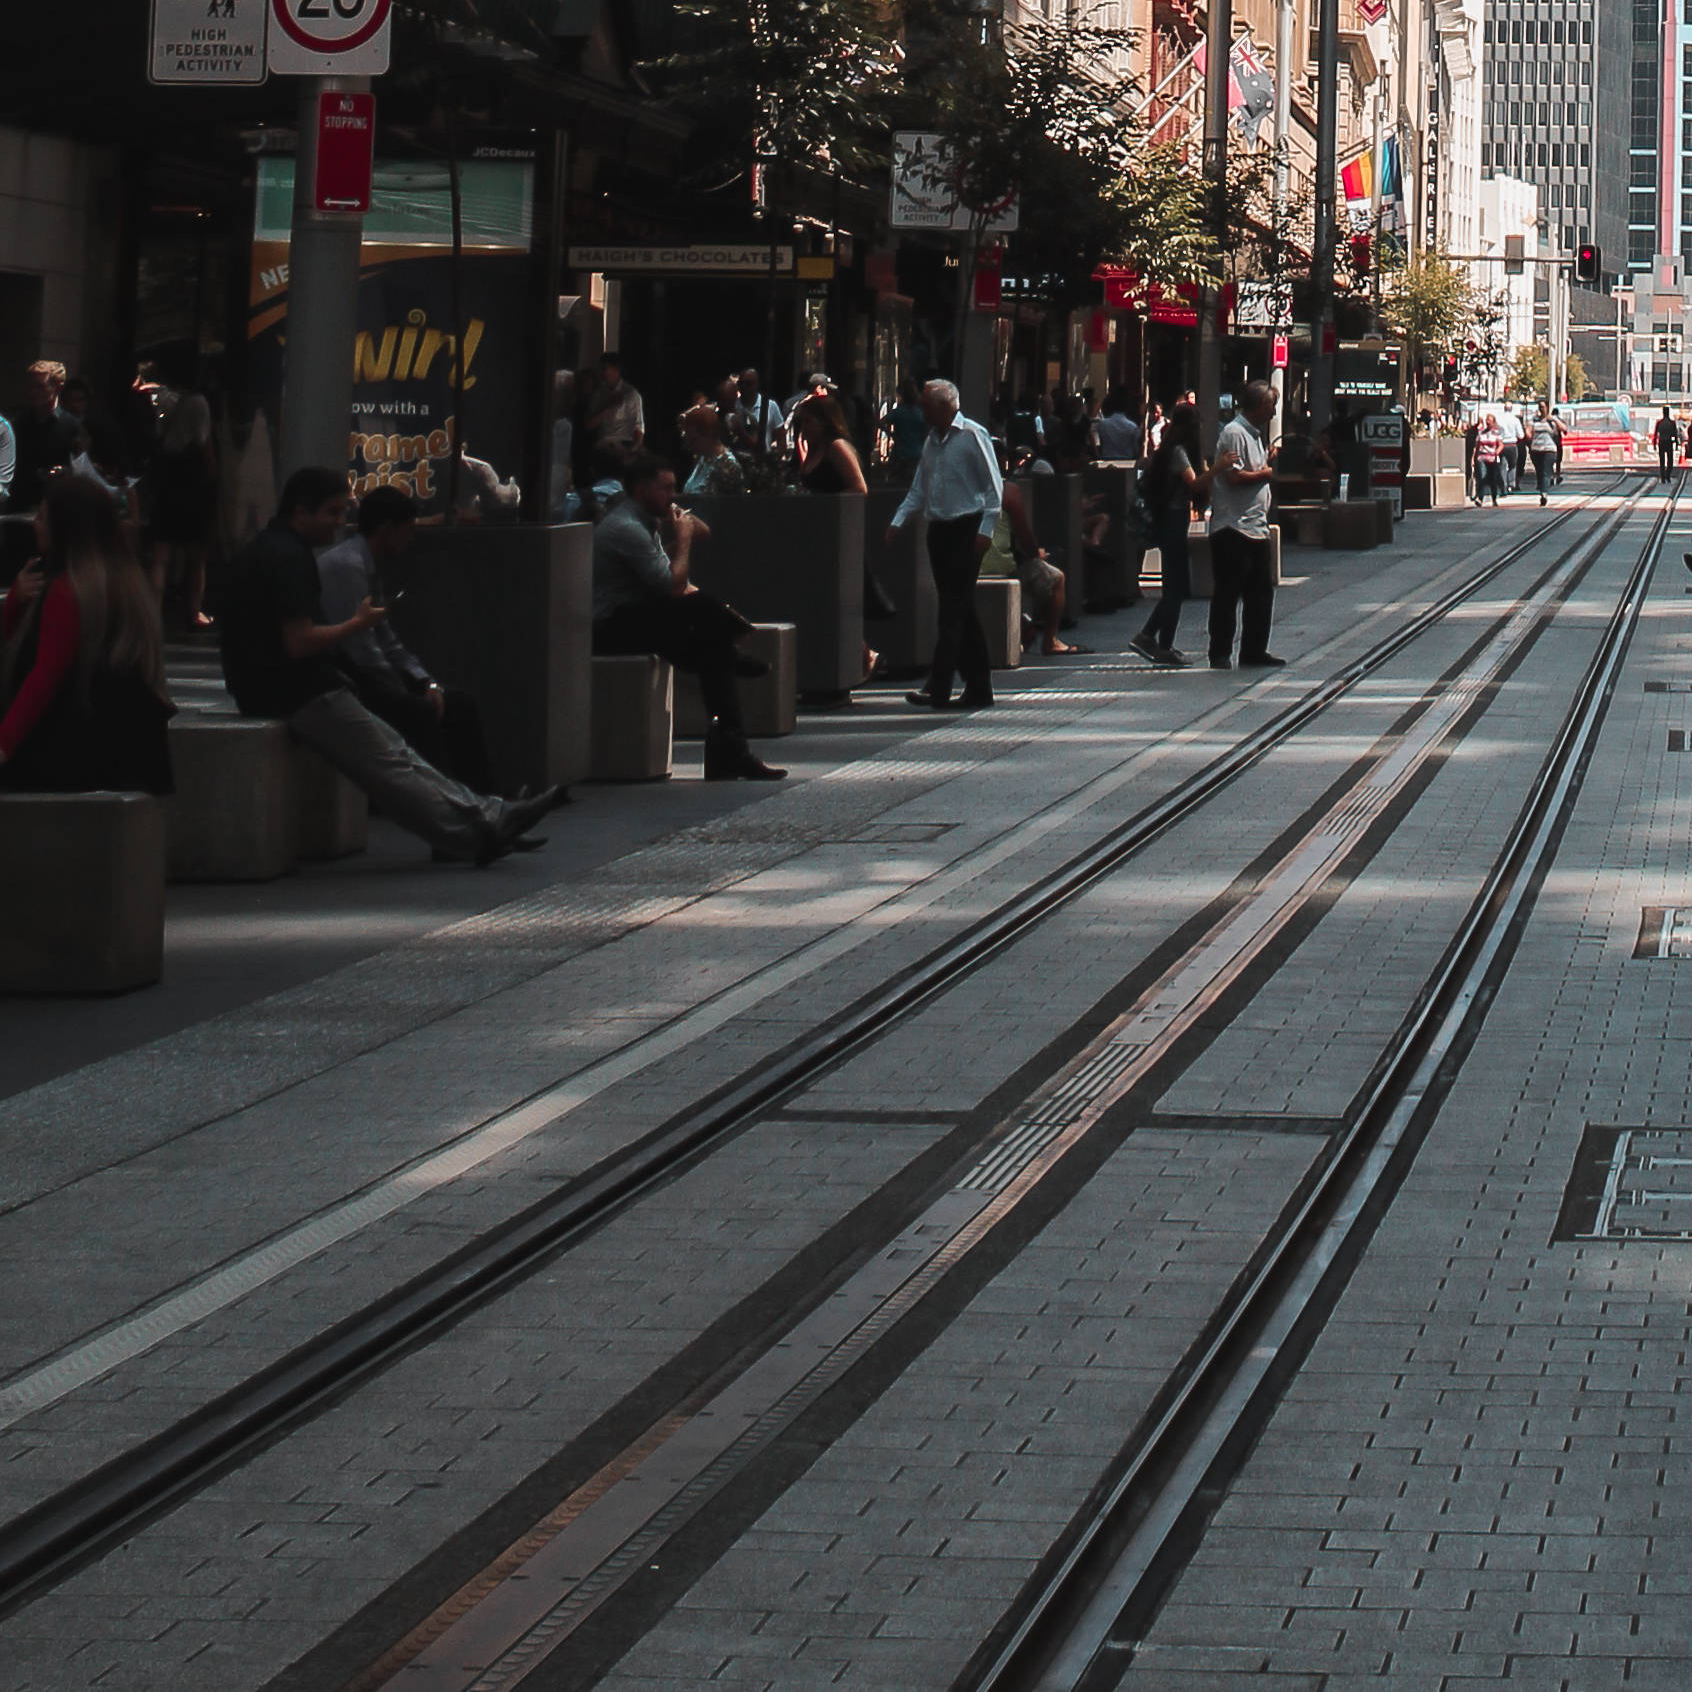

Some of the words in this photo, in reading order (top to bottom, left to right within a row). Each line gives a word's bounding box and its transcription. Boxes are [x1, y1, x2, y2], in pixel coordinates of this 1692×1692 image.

[191, 28, 227, 42] HIGH
[165, 44, 255, 58] PEDESTRIAN
[176, 59, 243, 73] ACTIVITY
[339, 100, 354, 112] NO
[324, 115, 368, 130] STOPPING
[472, 147, 536, 158] JCDecaux
[577, 250, 653, 263] HAIGH'S
[660, 251, 784, 264] CHOCOLATES
[259, 263, 290, 291] NE
[380, 401, 415, 415] with
[421, 405, 429, 415] a
[348, 415, 457, 463] ramel
